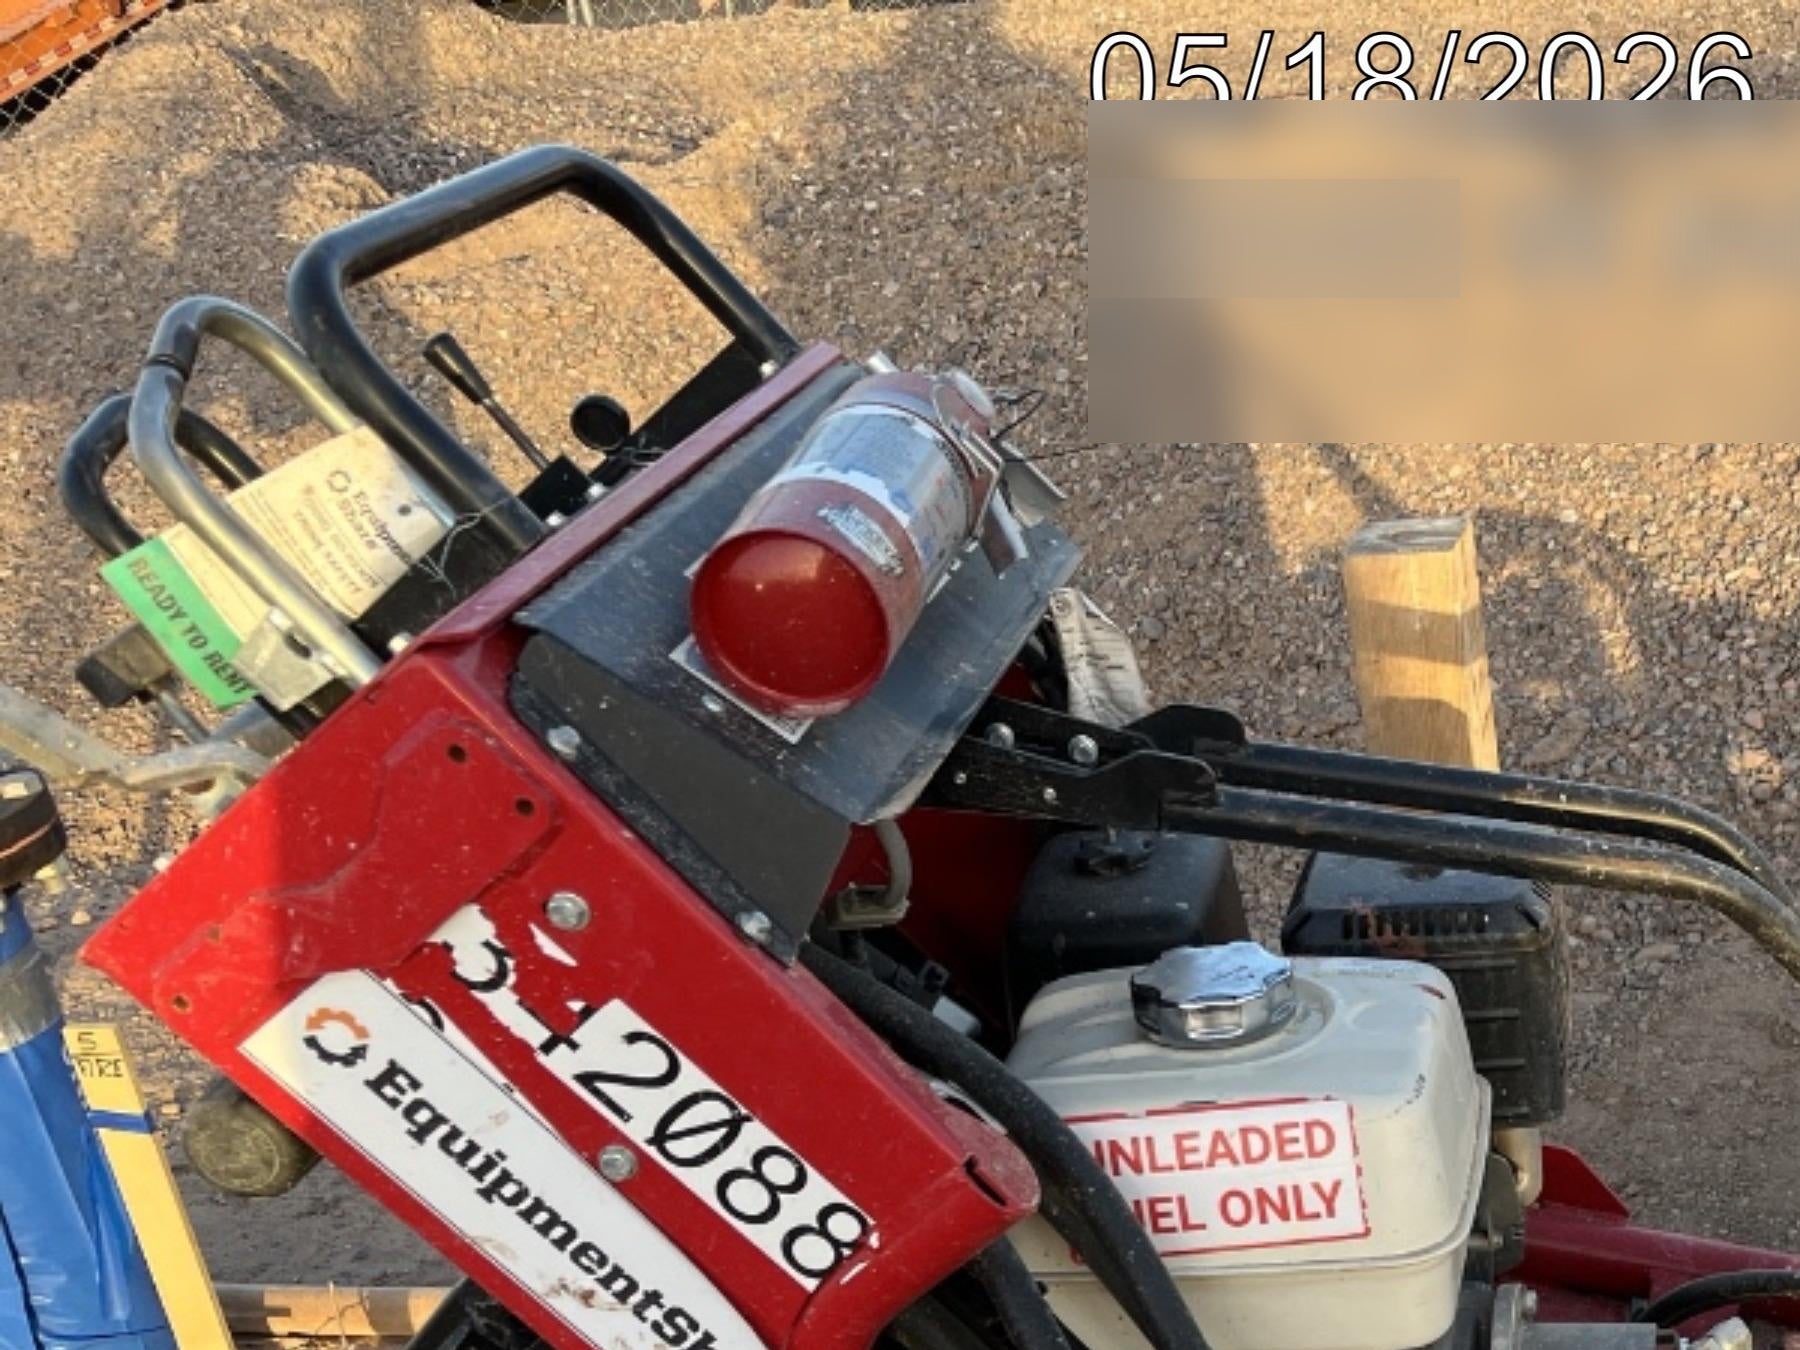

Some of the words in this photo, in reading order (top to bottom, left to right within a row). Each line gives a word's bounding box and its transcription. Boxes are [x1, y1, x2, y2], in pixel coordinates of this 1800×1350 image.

[127, 556, 188, 621] READY
[183, 622, 208, 650] TO
[202, 650, 251, 694] RENT
[1130, 1194, 1207, 1234] EL
[1218, 1179, 1343, 1228] ONLY
